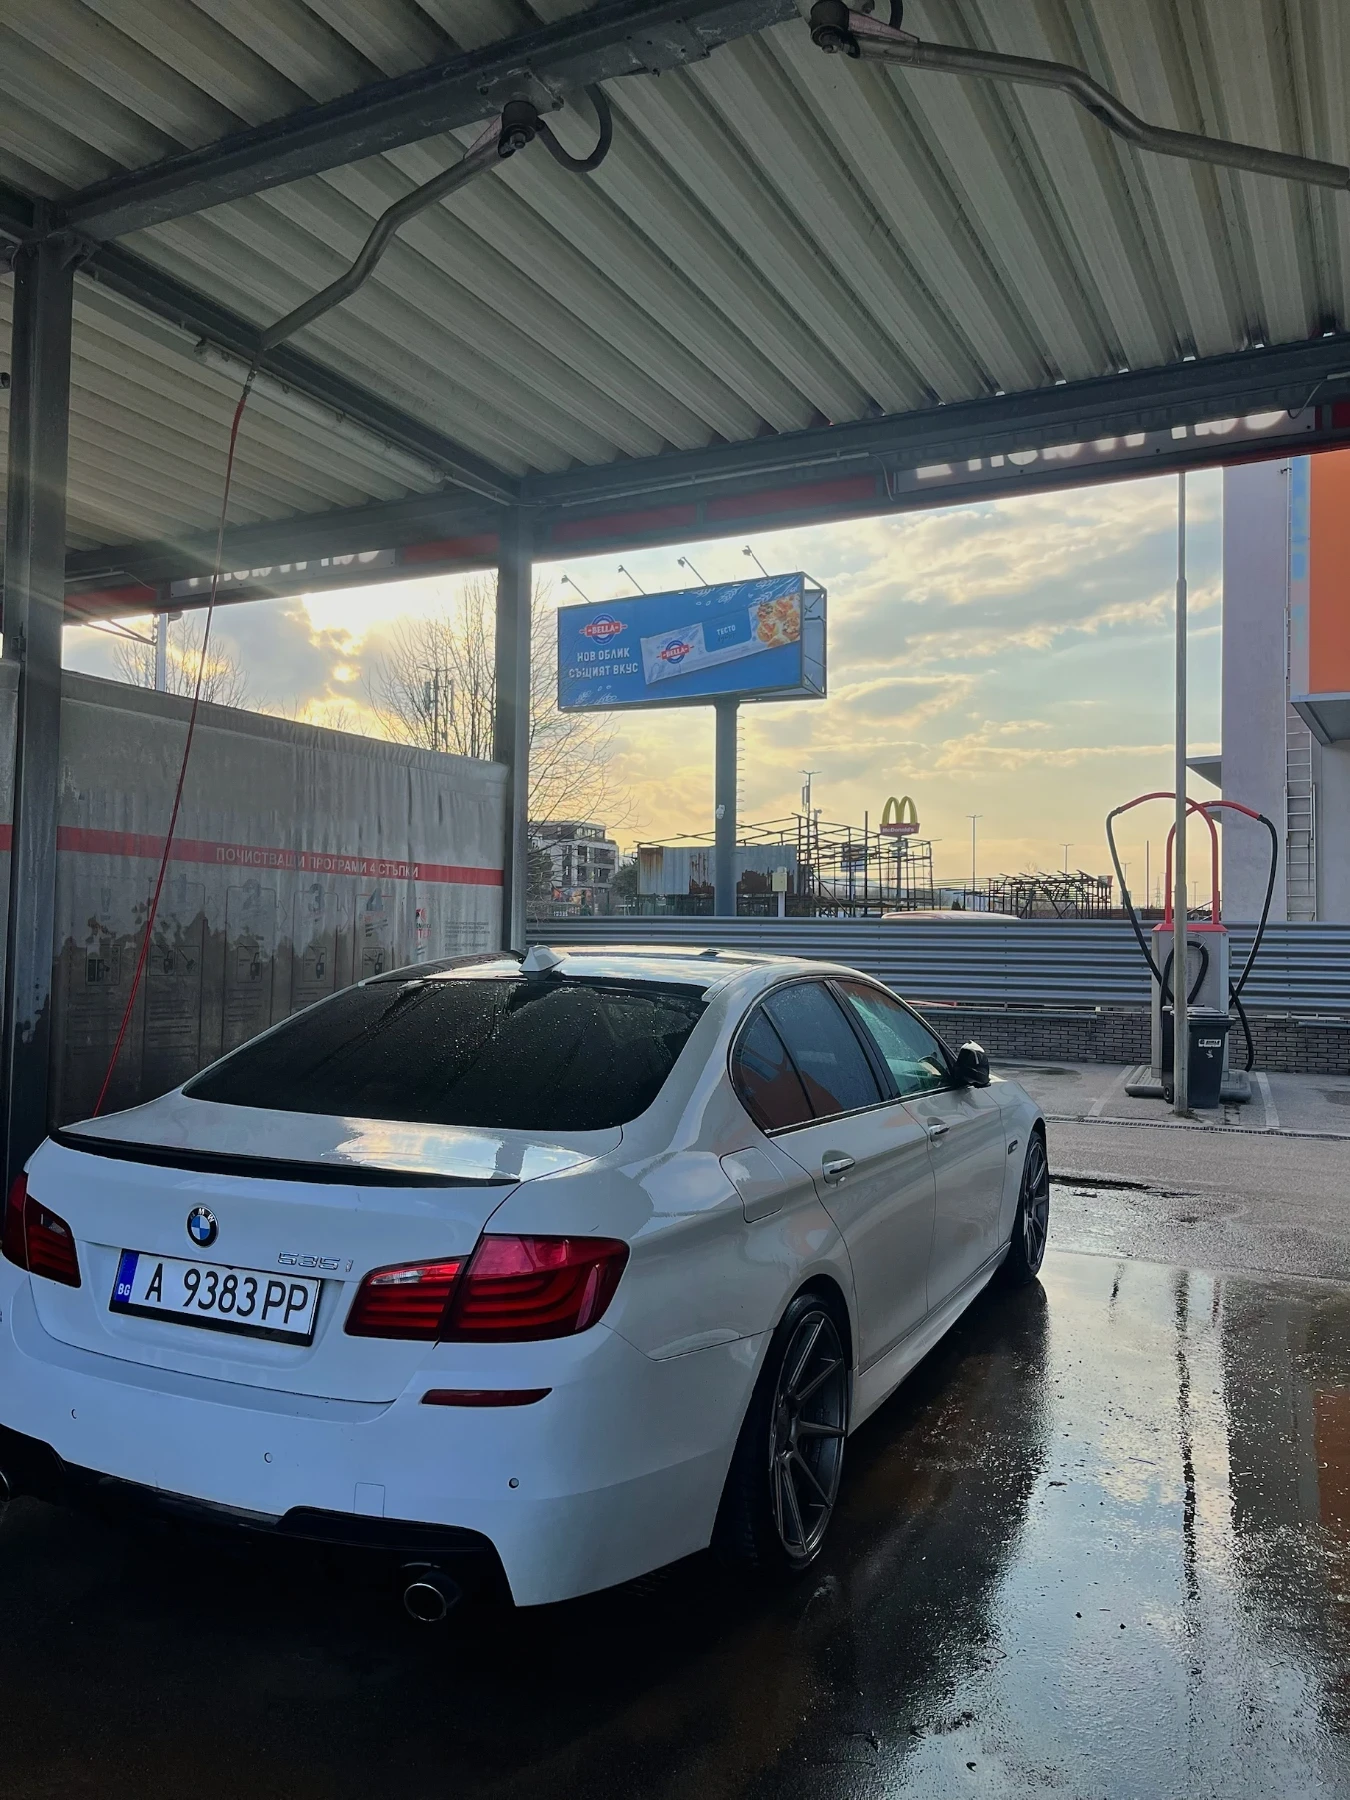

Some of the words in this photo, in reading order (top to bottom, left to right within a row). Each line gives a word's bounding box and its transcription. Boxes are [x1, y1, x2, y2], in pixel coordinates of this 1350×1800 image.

[592, 625, 615, 634] BELLA
[717, 625, 736, 635] ТЕСТО
[577, 652, 596, 662] НОВ
[598, 647, 630, 660] ОБЛИК
[666, 648, 685, 657] BELLA
[569, 665, 611, 679] СЪЩИЯТ
[613, 663, 638, 675] ВКУС
[216, 847, 305, 868] ПОЧИСТВАЩИ
[308, 856, 367, 874] ПРОГРАМИ
[369, 863, 377, 873] 4
[378, 864, 419, 879] СТЪПКИ
[117, 1283, 131, 1296] BG
[144, 1263, 164, 1303] A
